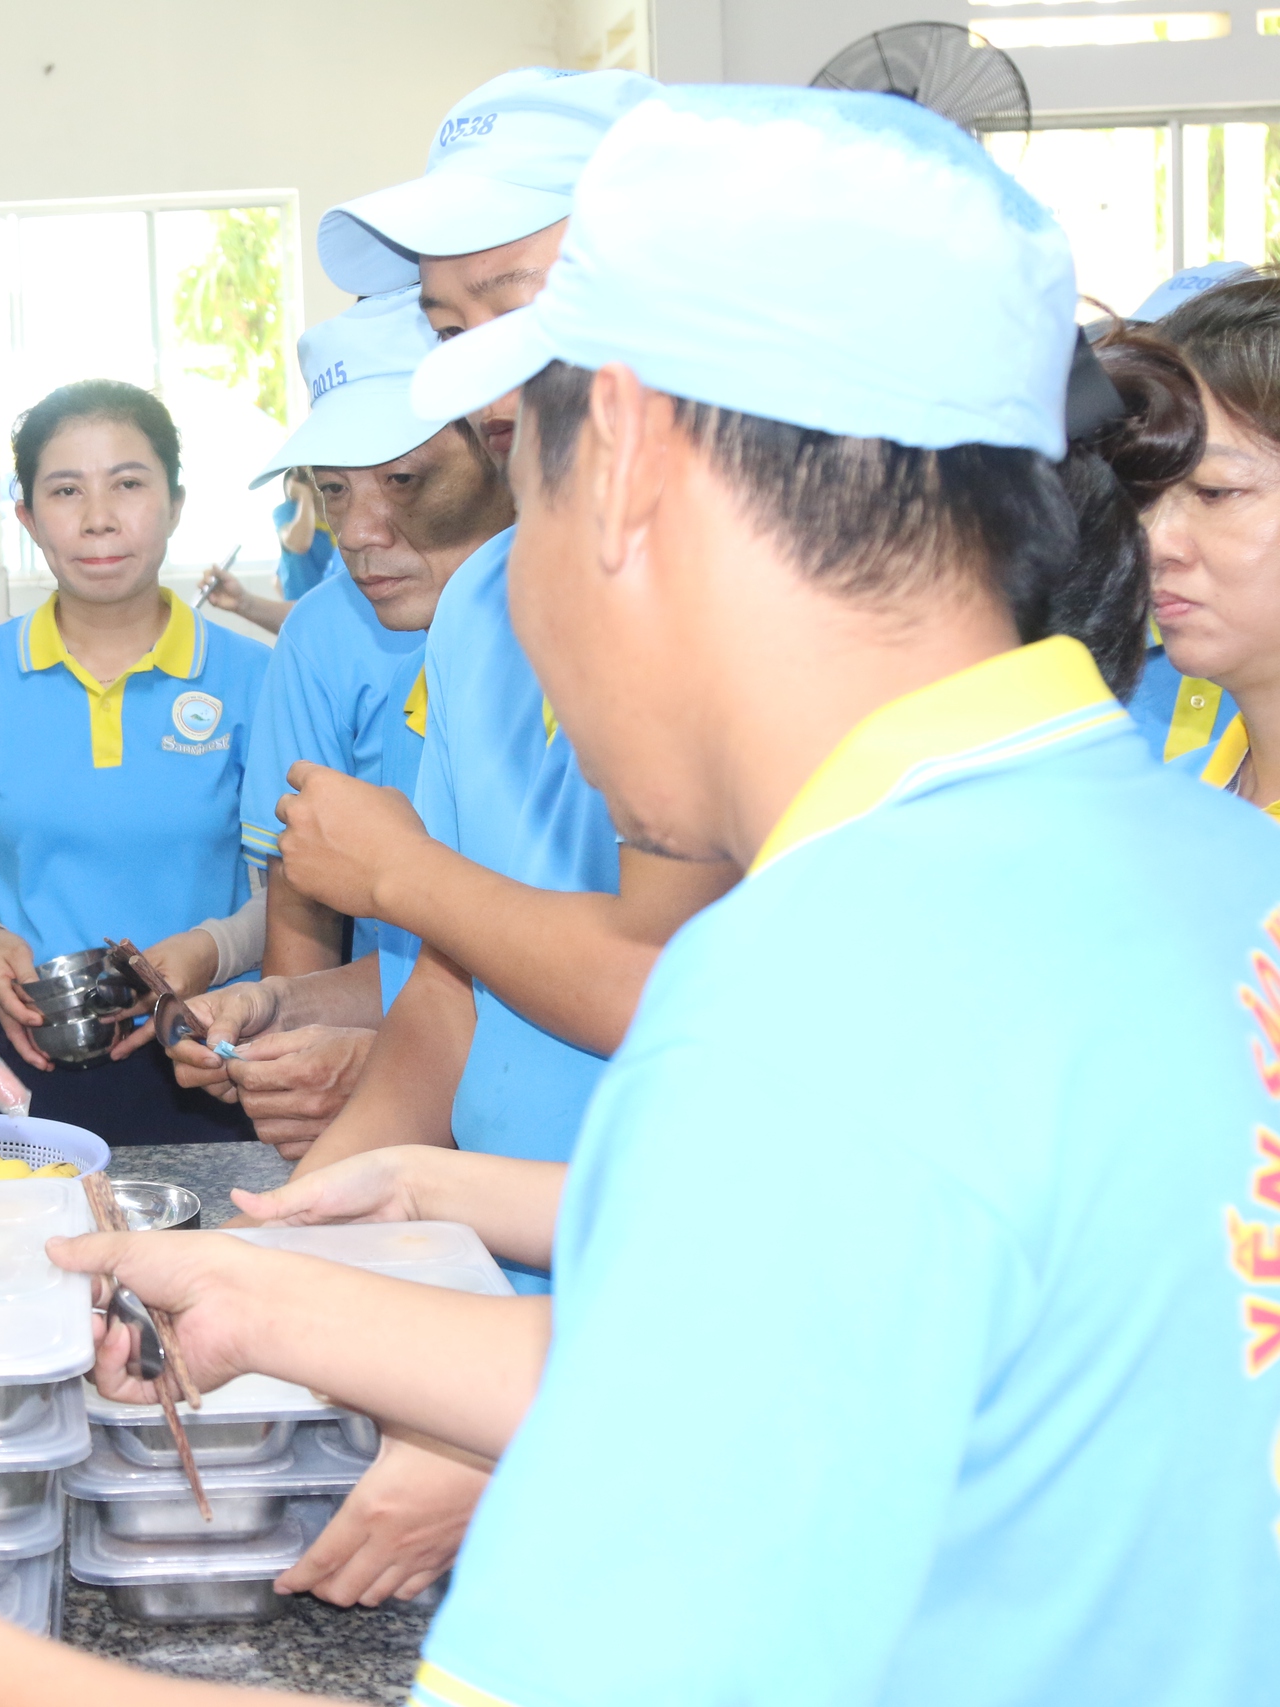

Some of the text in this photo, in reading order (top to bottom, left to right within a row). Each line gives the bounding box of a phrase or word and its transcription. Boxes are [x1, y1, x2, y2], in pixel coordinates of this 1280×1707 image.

[440, 113, 498, 147] 0538
[1169, 276, 1224, 291] 020
[312, 360, 347, 399] 0015
